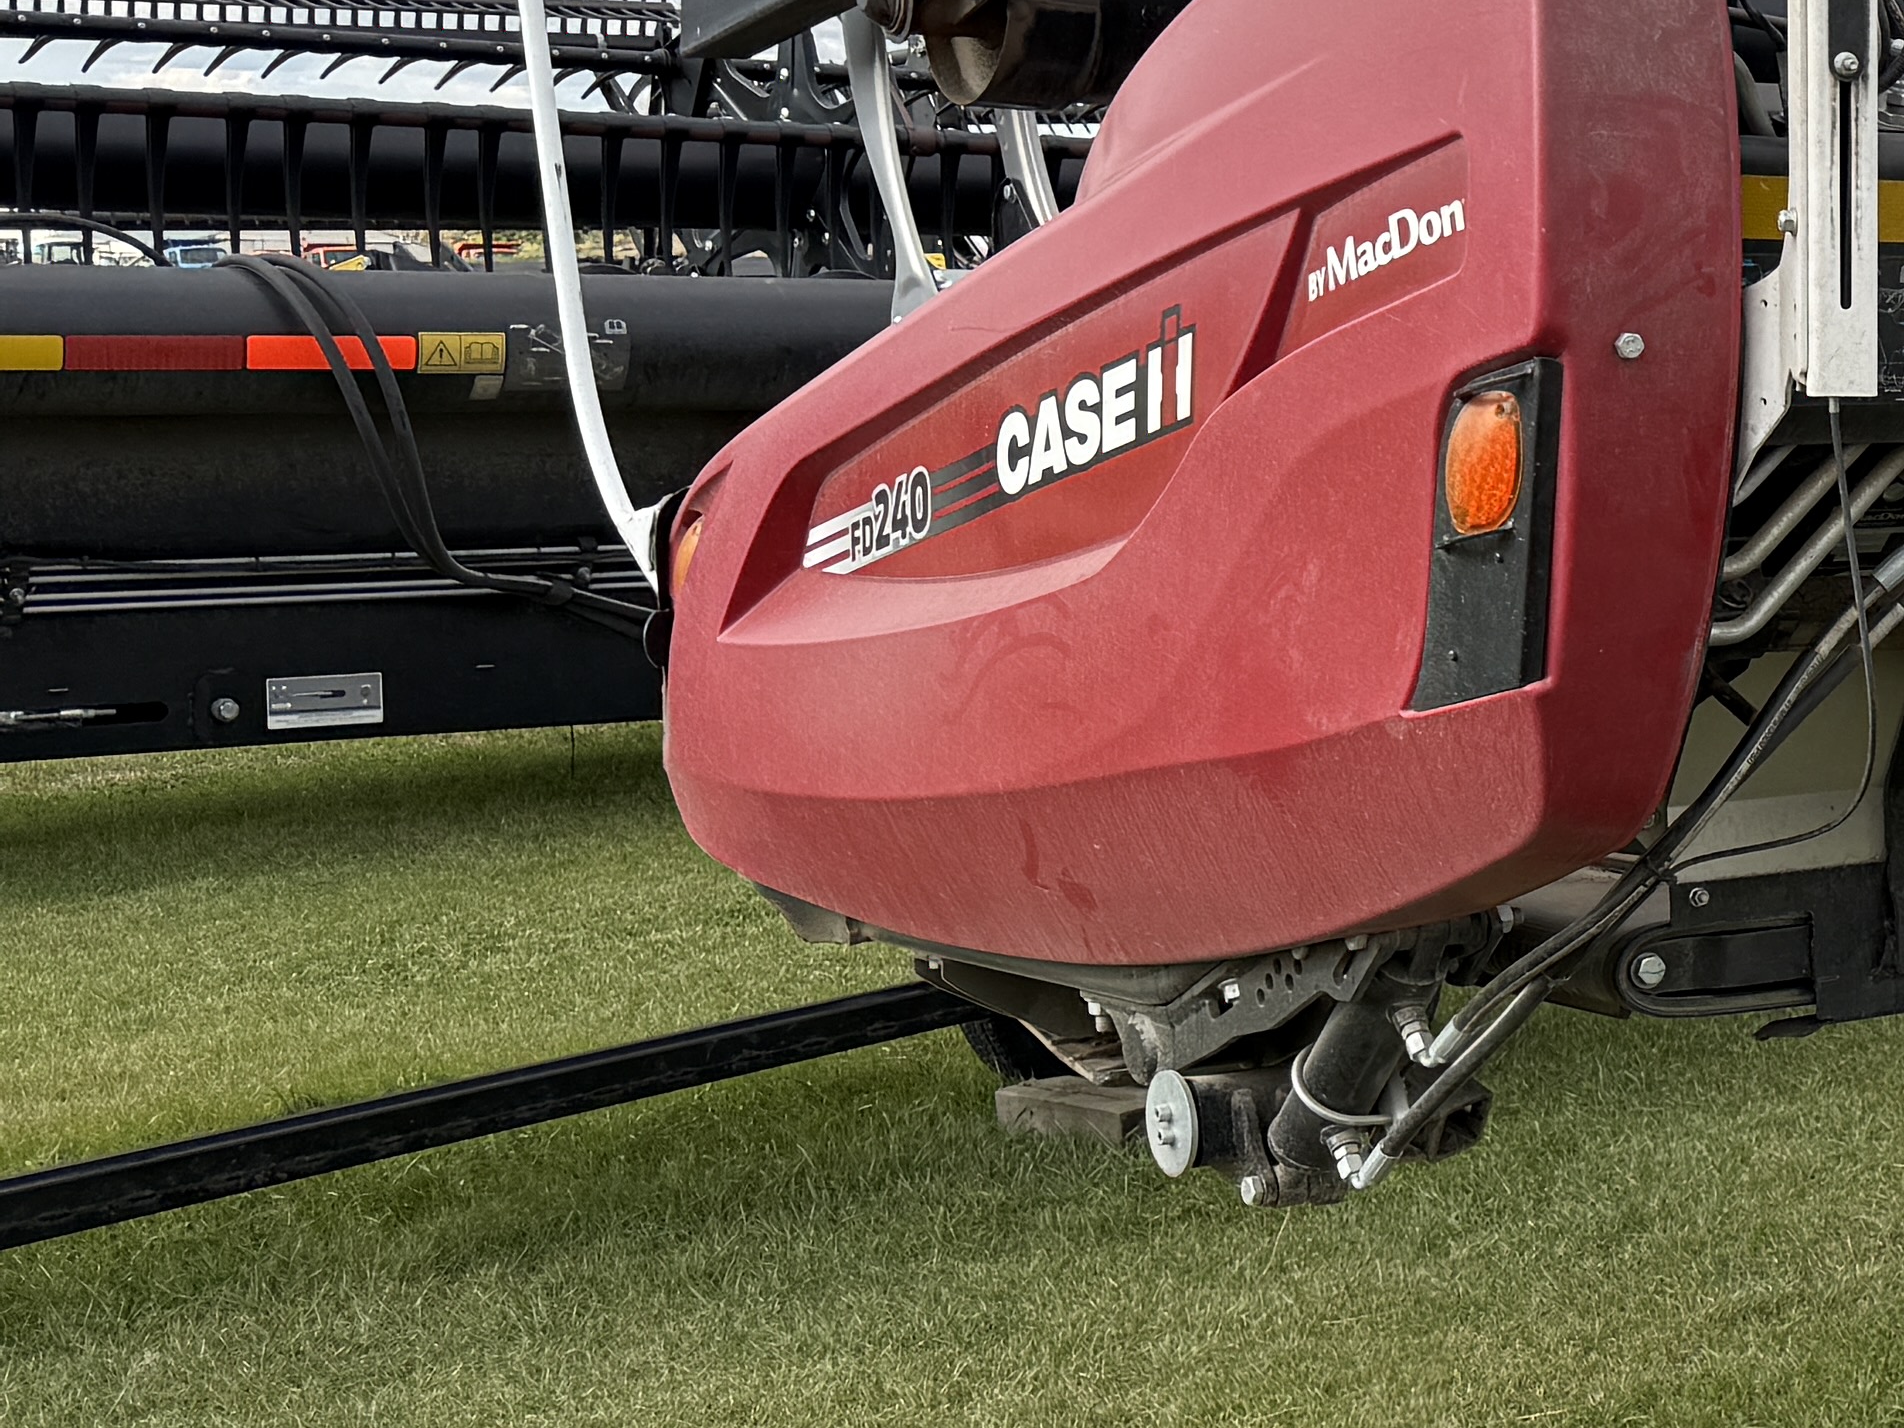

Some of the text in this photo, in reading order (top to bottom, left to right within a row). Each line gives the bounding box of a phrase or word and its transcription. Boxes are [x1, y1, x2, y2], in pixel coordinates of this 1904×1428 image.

[1308, 200, 1467, 302] BY MacDon
[849, 467, 931, 563] FD240
[996, 356, 1138, 496] CASE
